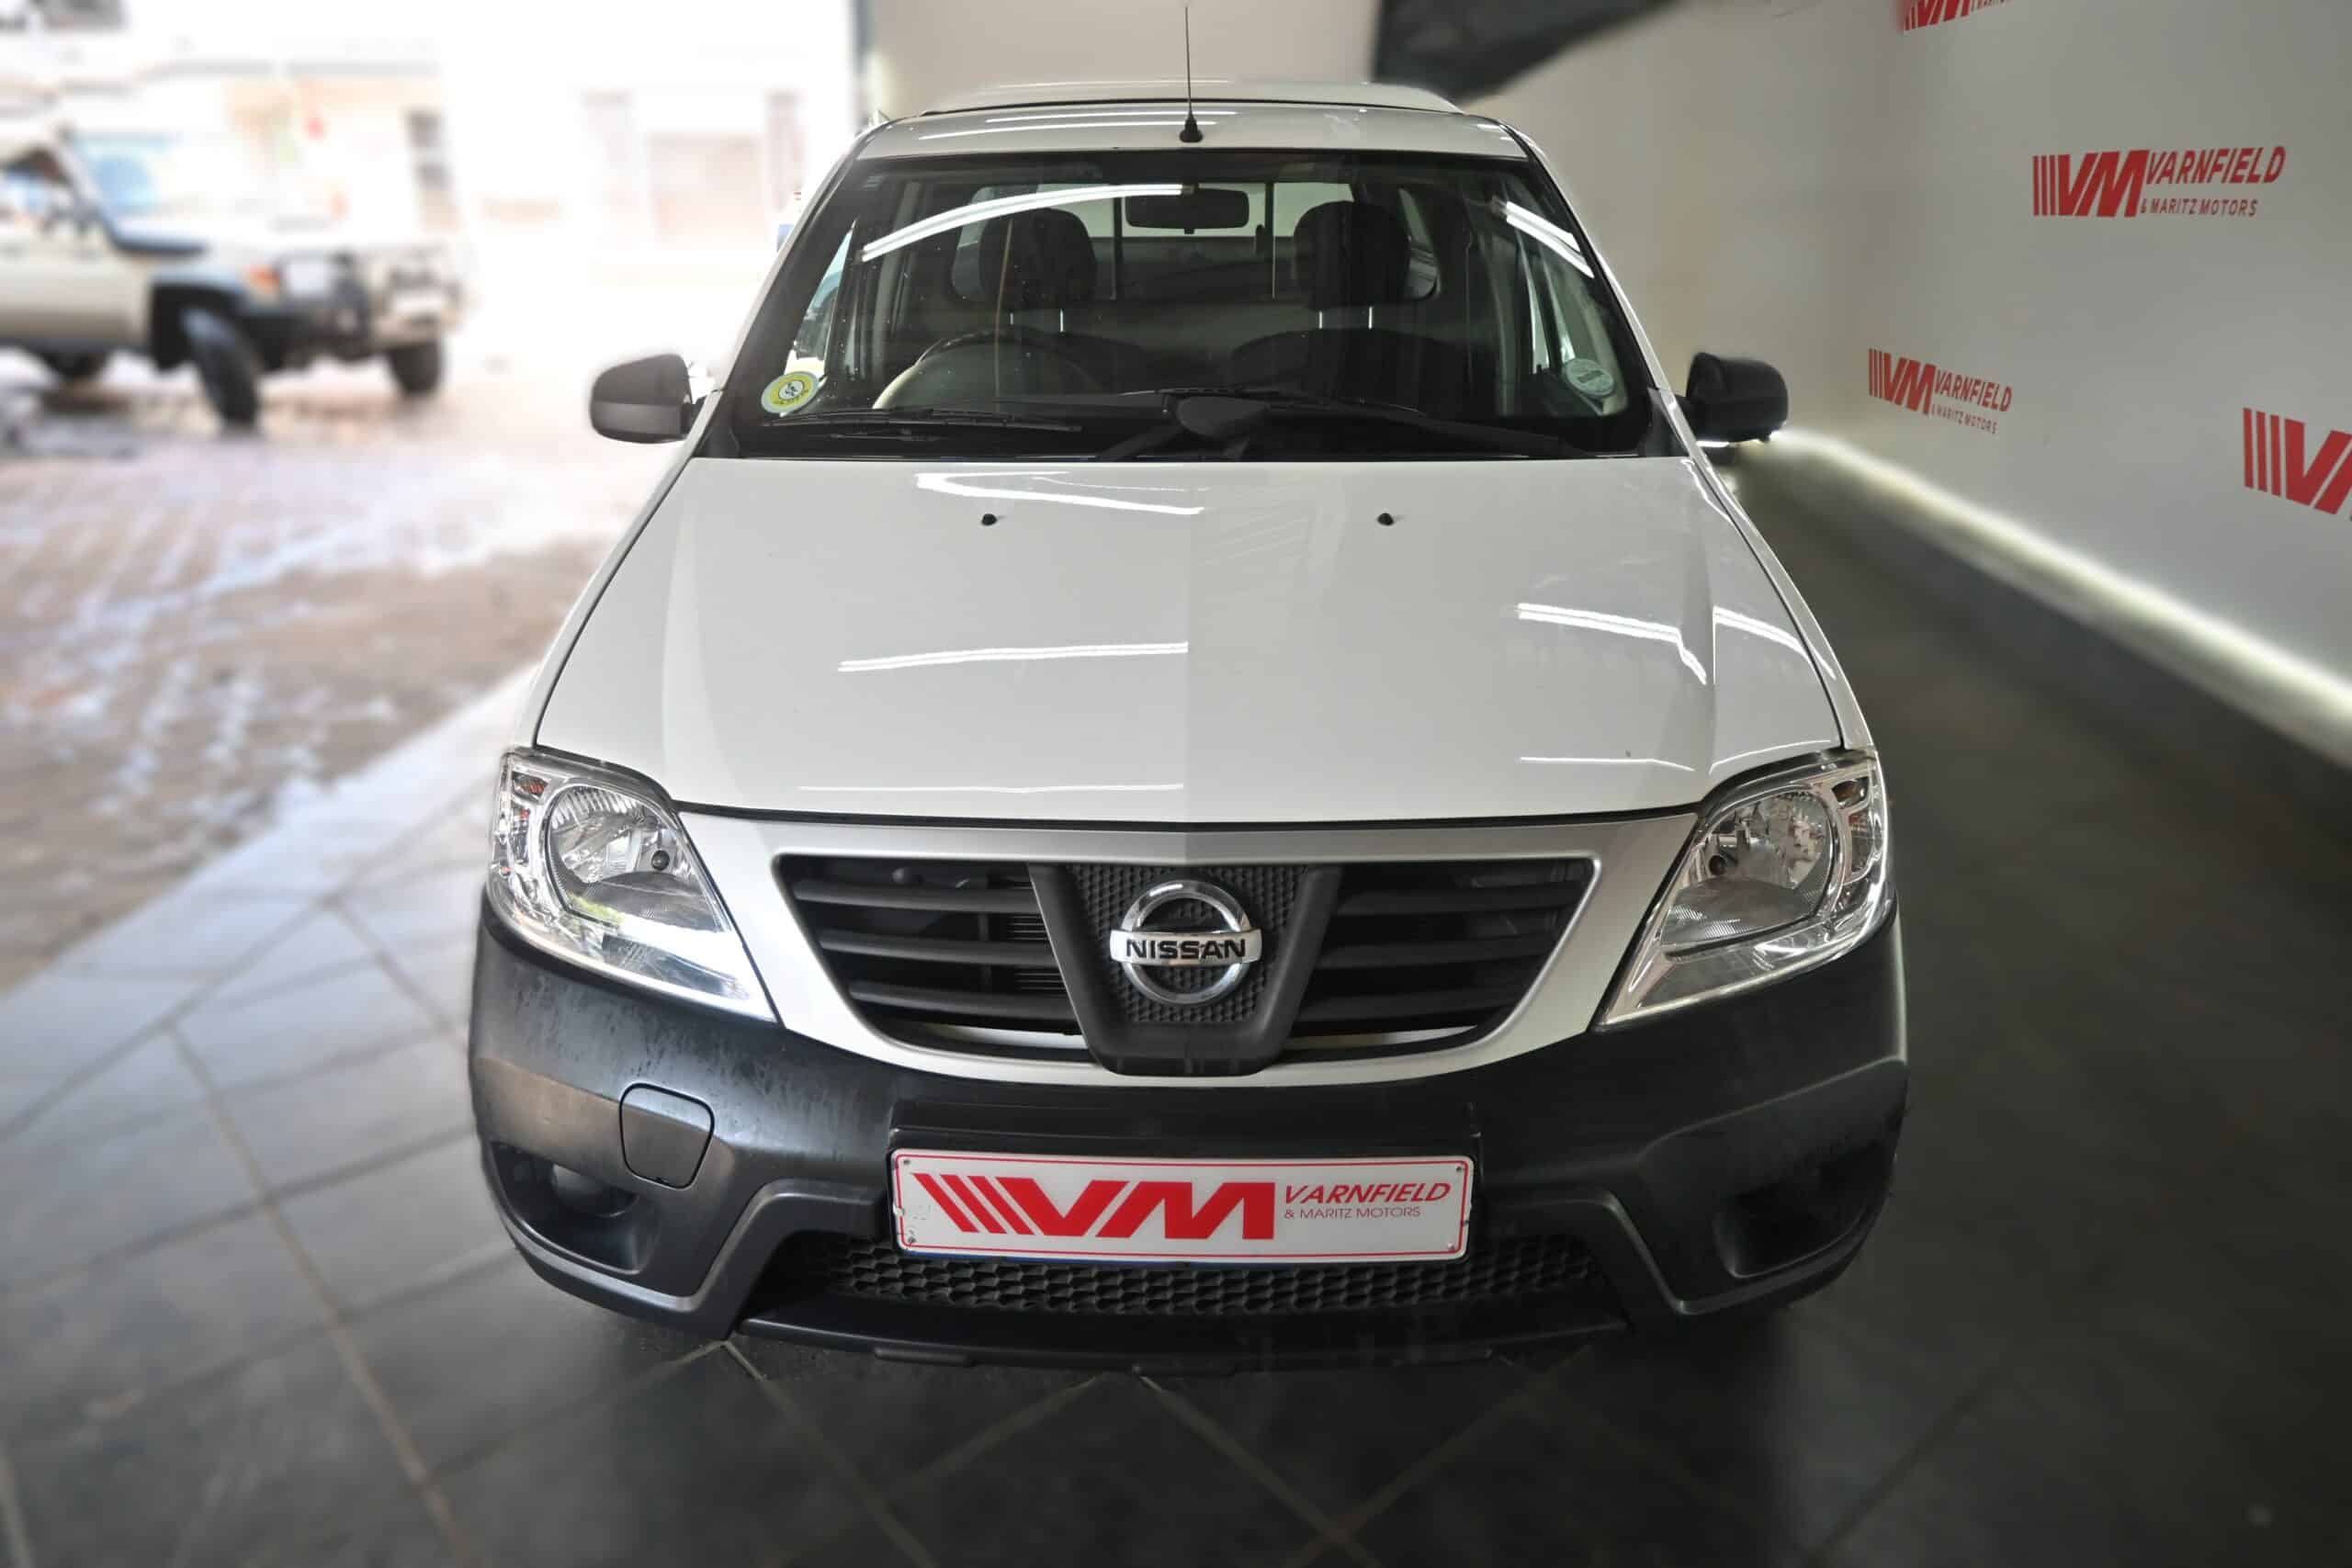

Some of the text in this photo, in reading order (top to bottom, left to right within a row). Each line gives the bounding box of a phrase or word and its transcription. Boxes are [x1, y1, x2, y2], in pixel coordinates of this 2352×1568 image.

[2057, 150, 2150, 218] VM
[2145, 145, 2287, 185] VARNFIELD
[2149, 197, 2198, 215] MARITZ
[2199, 198, 2258, 218] MOTORS
[1883, 352, 1937, 415] VM
[1934, 369, 2013, 412] VARNFIELD
[1126, 938, 1246, 960] NISSAN
[994, 1176, 1276, 1240] VM
[1283, 1205, 1421, 1220] & MARITZ MOTORS
[1285, 1182, 1452, 1204] VARNFIELD
